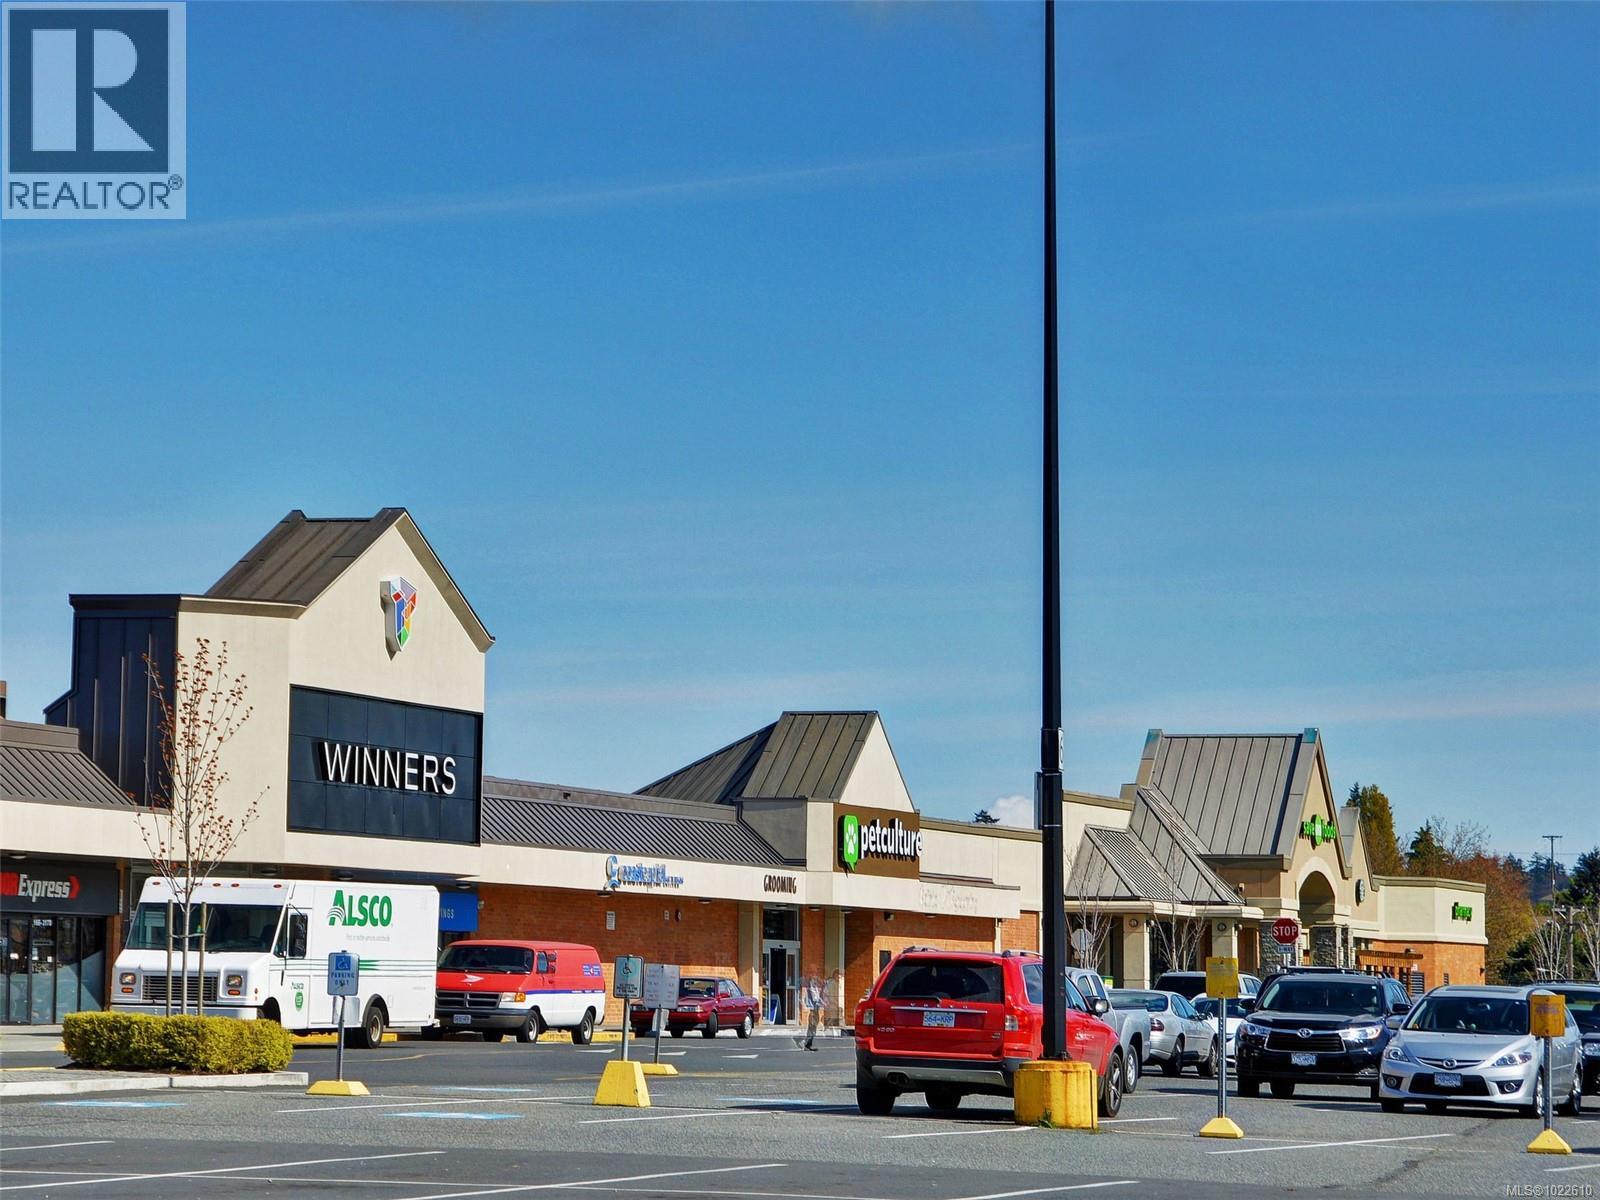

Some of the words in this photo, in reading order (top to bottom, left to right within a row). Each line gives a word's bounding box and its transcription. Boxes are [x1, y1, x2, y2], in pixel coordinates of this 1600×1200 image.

[323, 741, 456, 796] WINNERS
[860, 818, 923, 860] petculture
[18, 873, 71, 903] Express
[763, 874, 797, 894] GROOMING
[327, 889, 393, 927] ALSCO
[1273, 926, 1297, 937] STOP
